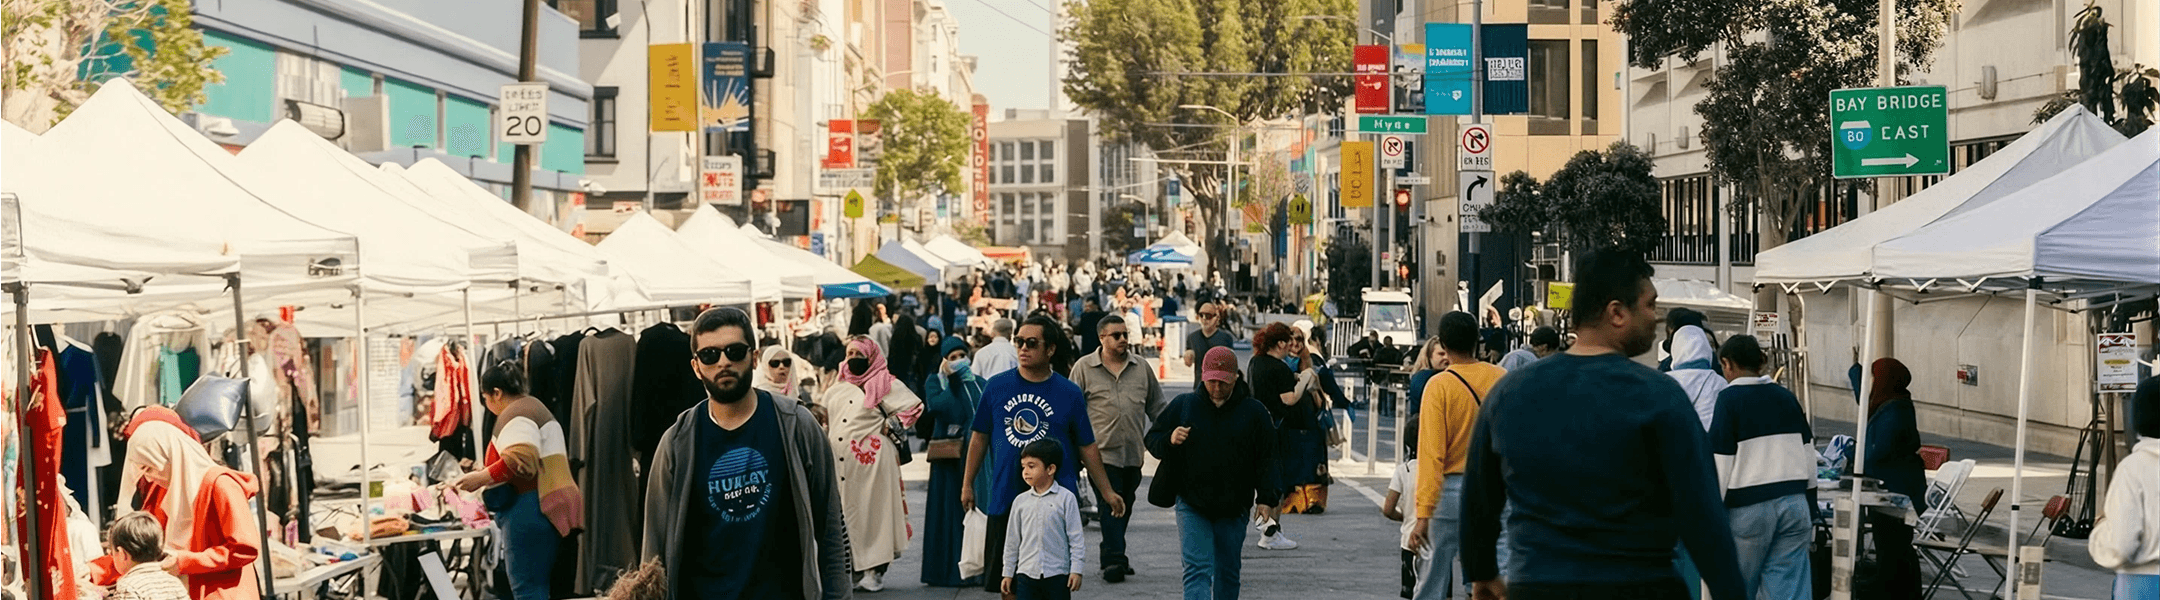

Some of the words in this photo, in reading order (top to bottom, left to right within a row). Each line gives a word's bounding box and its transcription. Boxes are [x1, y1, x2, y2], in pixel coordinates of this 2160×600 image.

[1836, 97, 1867, 112] BAY
[1877, 94, 1942, 110] BRIDGE
[506, 115, 542, 136] 20
[1881, 125, 1929, 140] EAST
